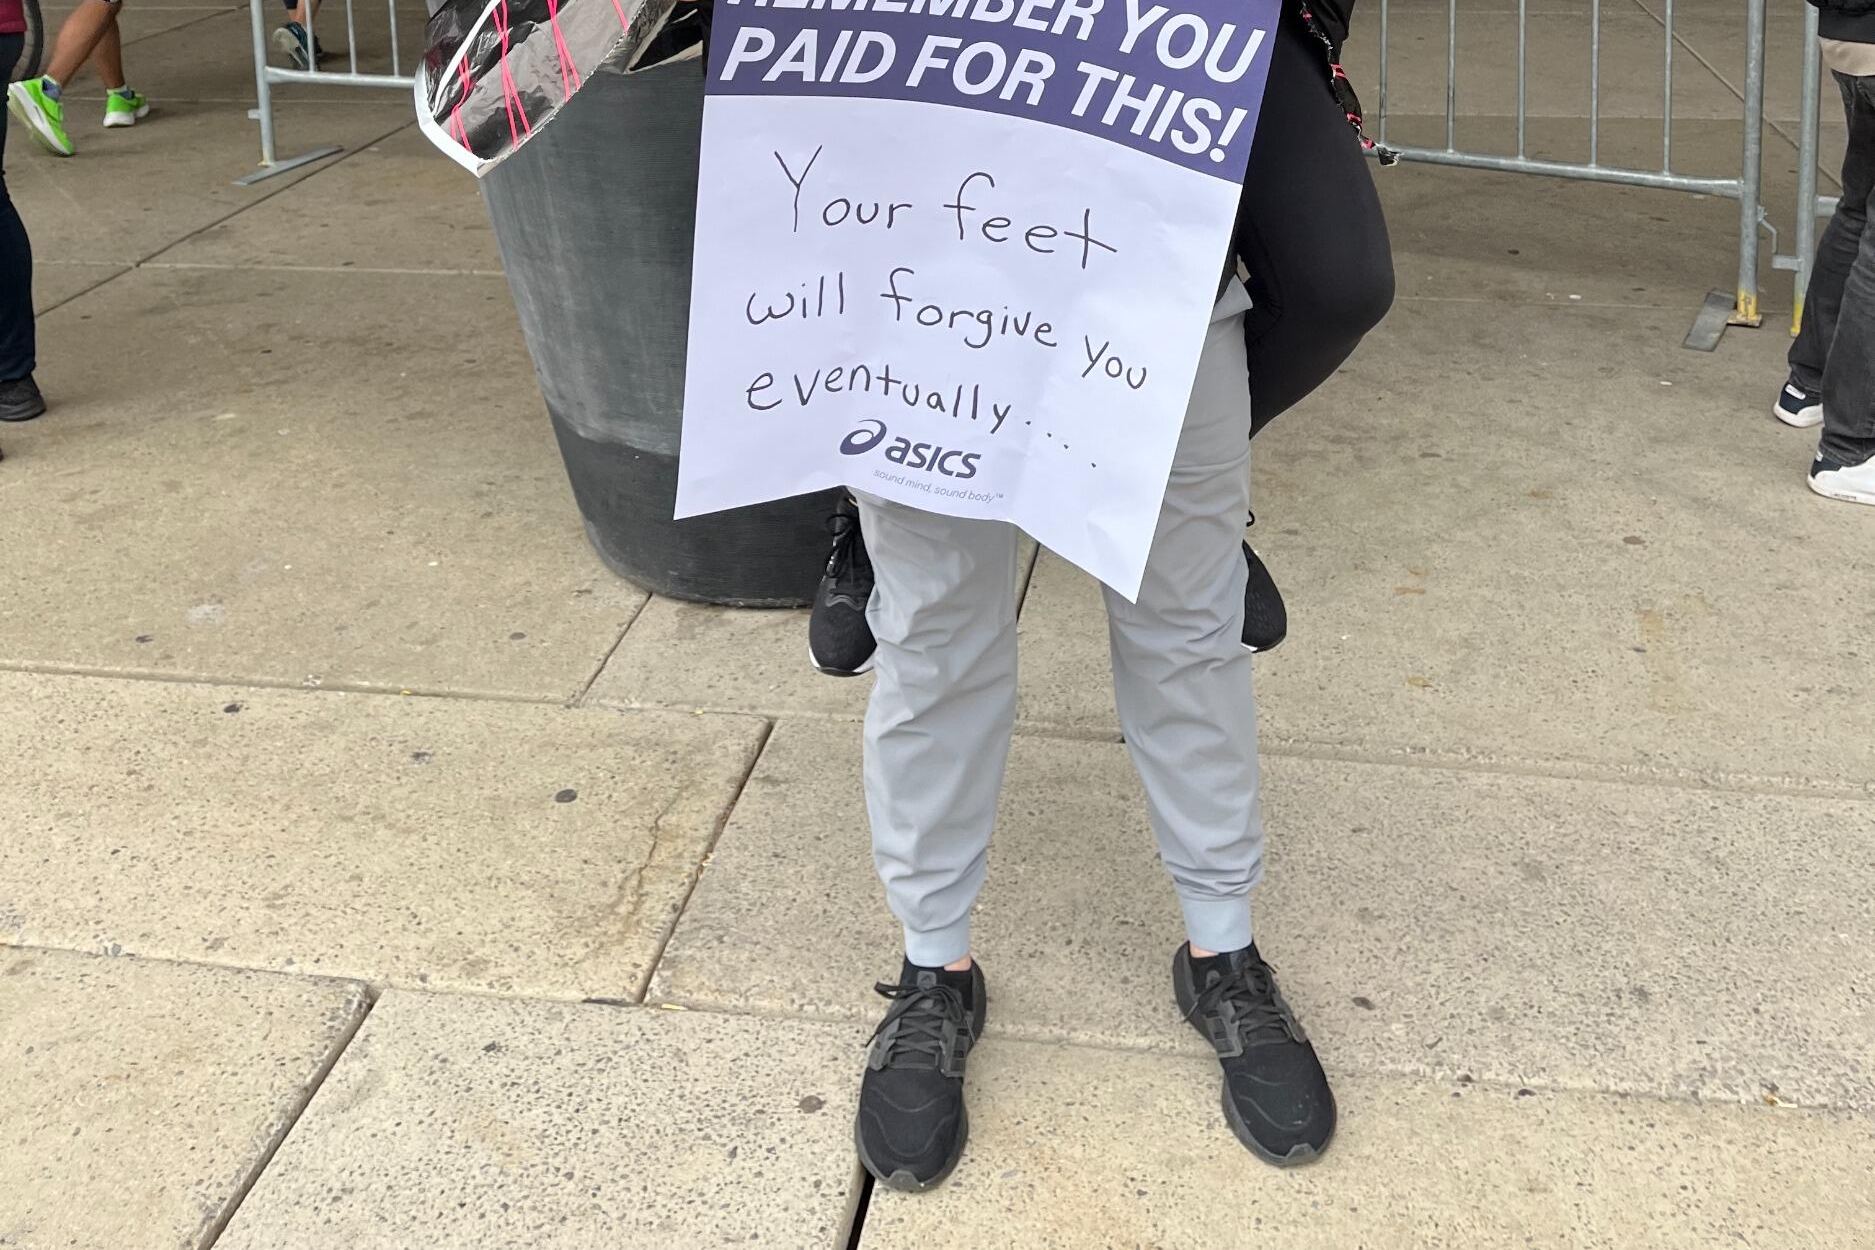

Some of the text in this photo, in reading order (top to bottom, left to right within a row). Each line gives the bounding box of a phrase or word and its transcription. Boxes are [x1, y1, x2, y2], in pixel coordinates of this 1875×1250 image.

[719, 26, 1249, 163] PAID FOR THIS!
[774, 144, 1118, 270] Your feet
[746, 271, 845, 326] will
[879, 267, 1058, 349] forgive
[872, 469, 905, 486] sound
[904, 479, 933, 494] mind,
[934, 485, 967, 499] sound
